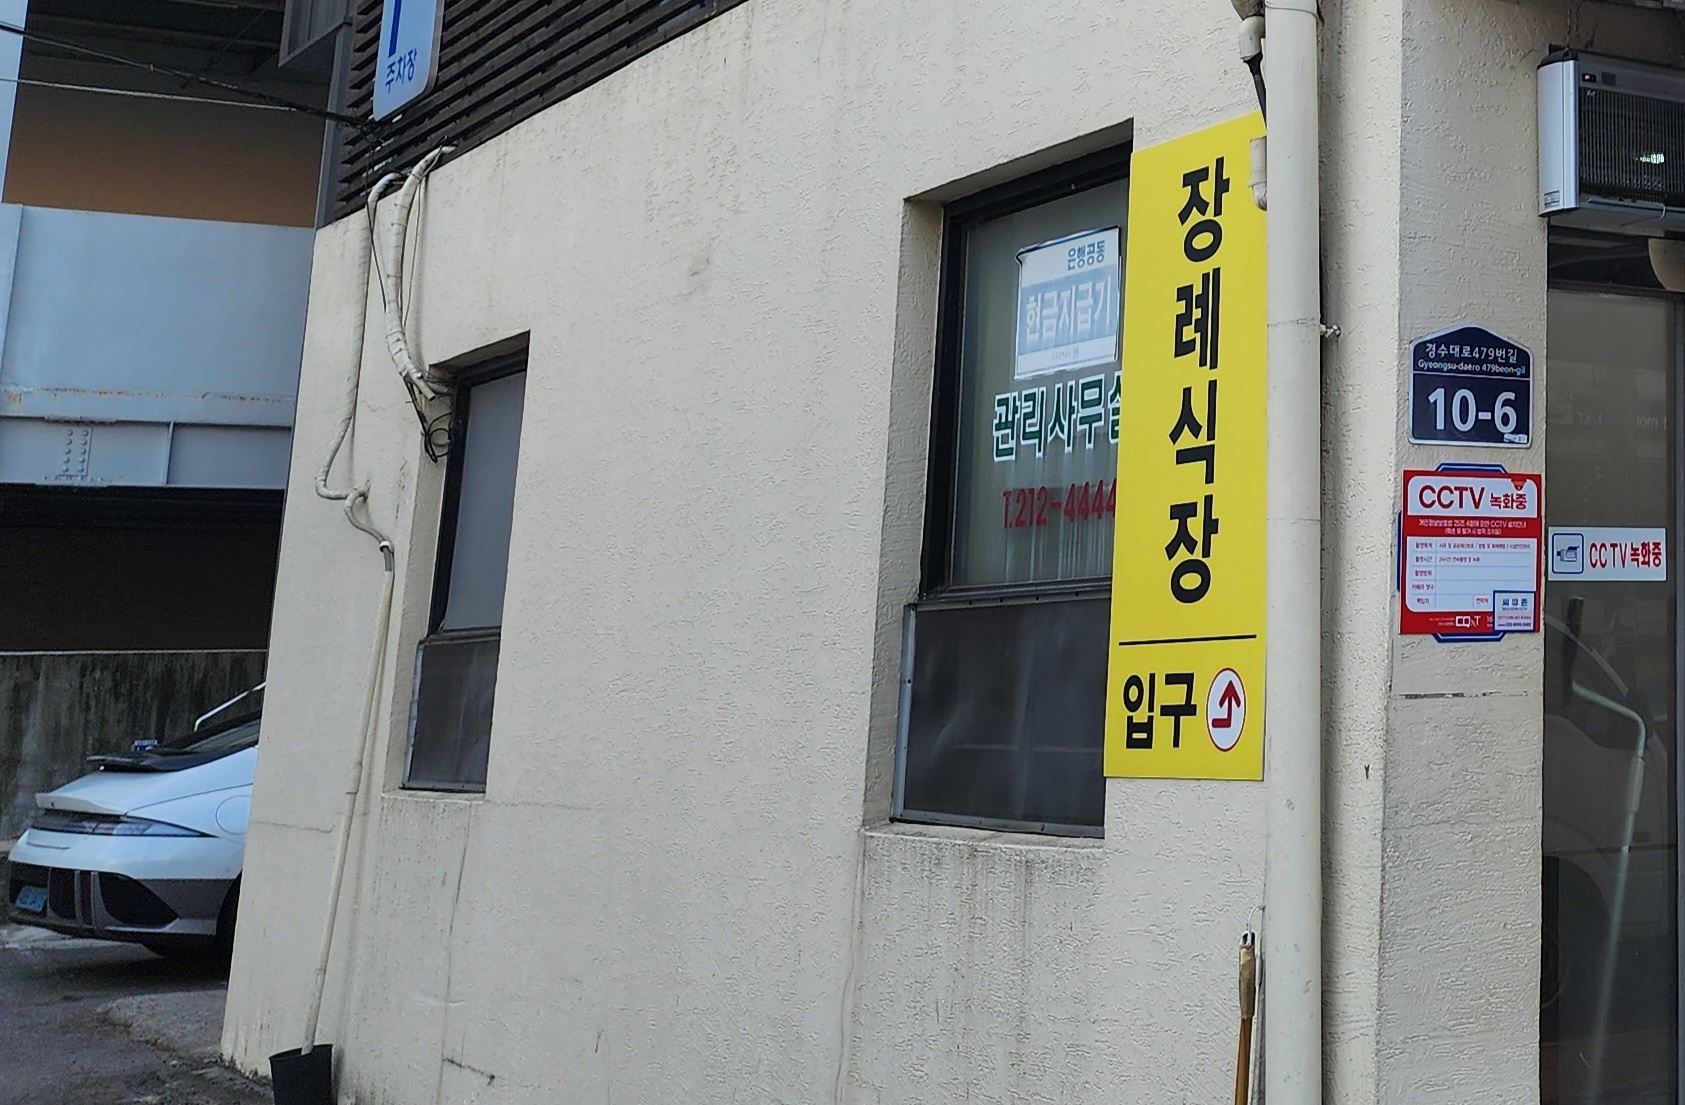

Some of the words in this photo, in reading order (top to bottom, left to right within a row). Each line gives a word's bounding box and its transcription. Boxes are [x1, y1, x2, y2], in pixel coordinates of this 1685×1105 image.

[385, 48, 417, 93] 주차장
[1067, 239, 1105, 271] 은행공동
[1025, 275, 1111, 345] 현금지급기
[1418, 359, 1480, 372] Gyeongsu-daero
[1482, 363, 1525, 376] 479beon-gil
[1425, 343, 1517, 363] 경수대로479번길
[1164, 156, 1229, 605] 장례식장
[1428, 388, 1517, 433] 10-6
[1419, 485, 1485, 509] CCTV
[1490, 492, 1527, 510] 녹화중
[1590, 542, 1627, 568] CCTV
[1630, 541, 1662, 568] 녹화중
[1122, 671, 1197, 751] 입구
